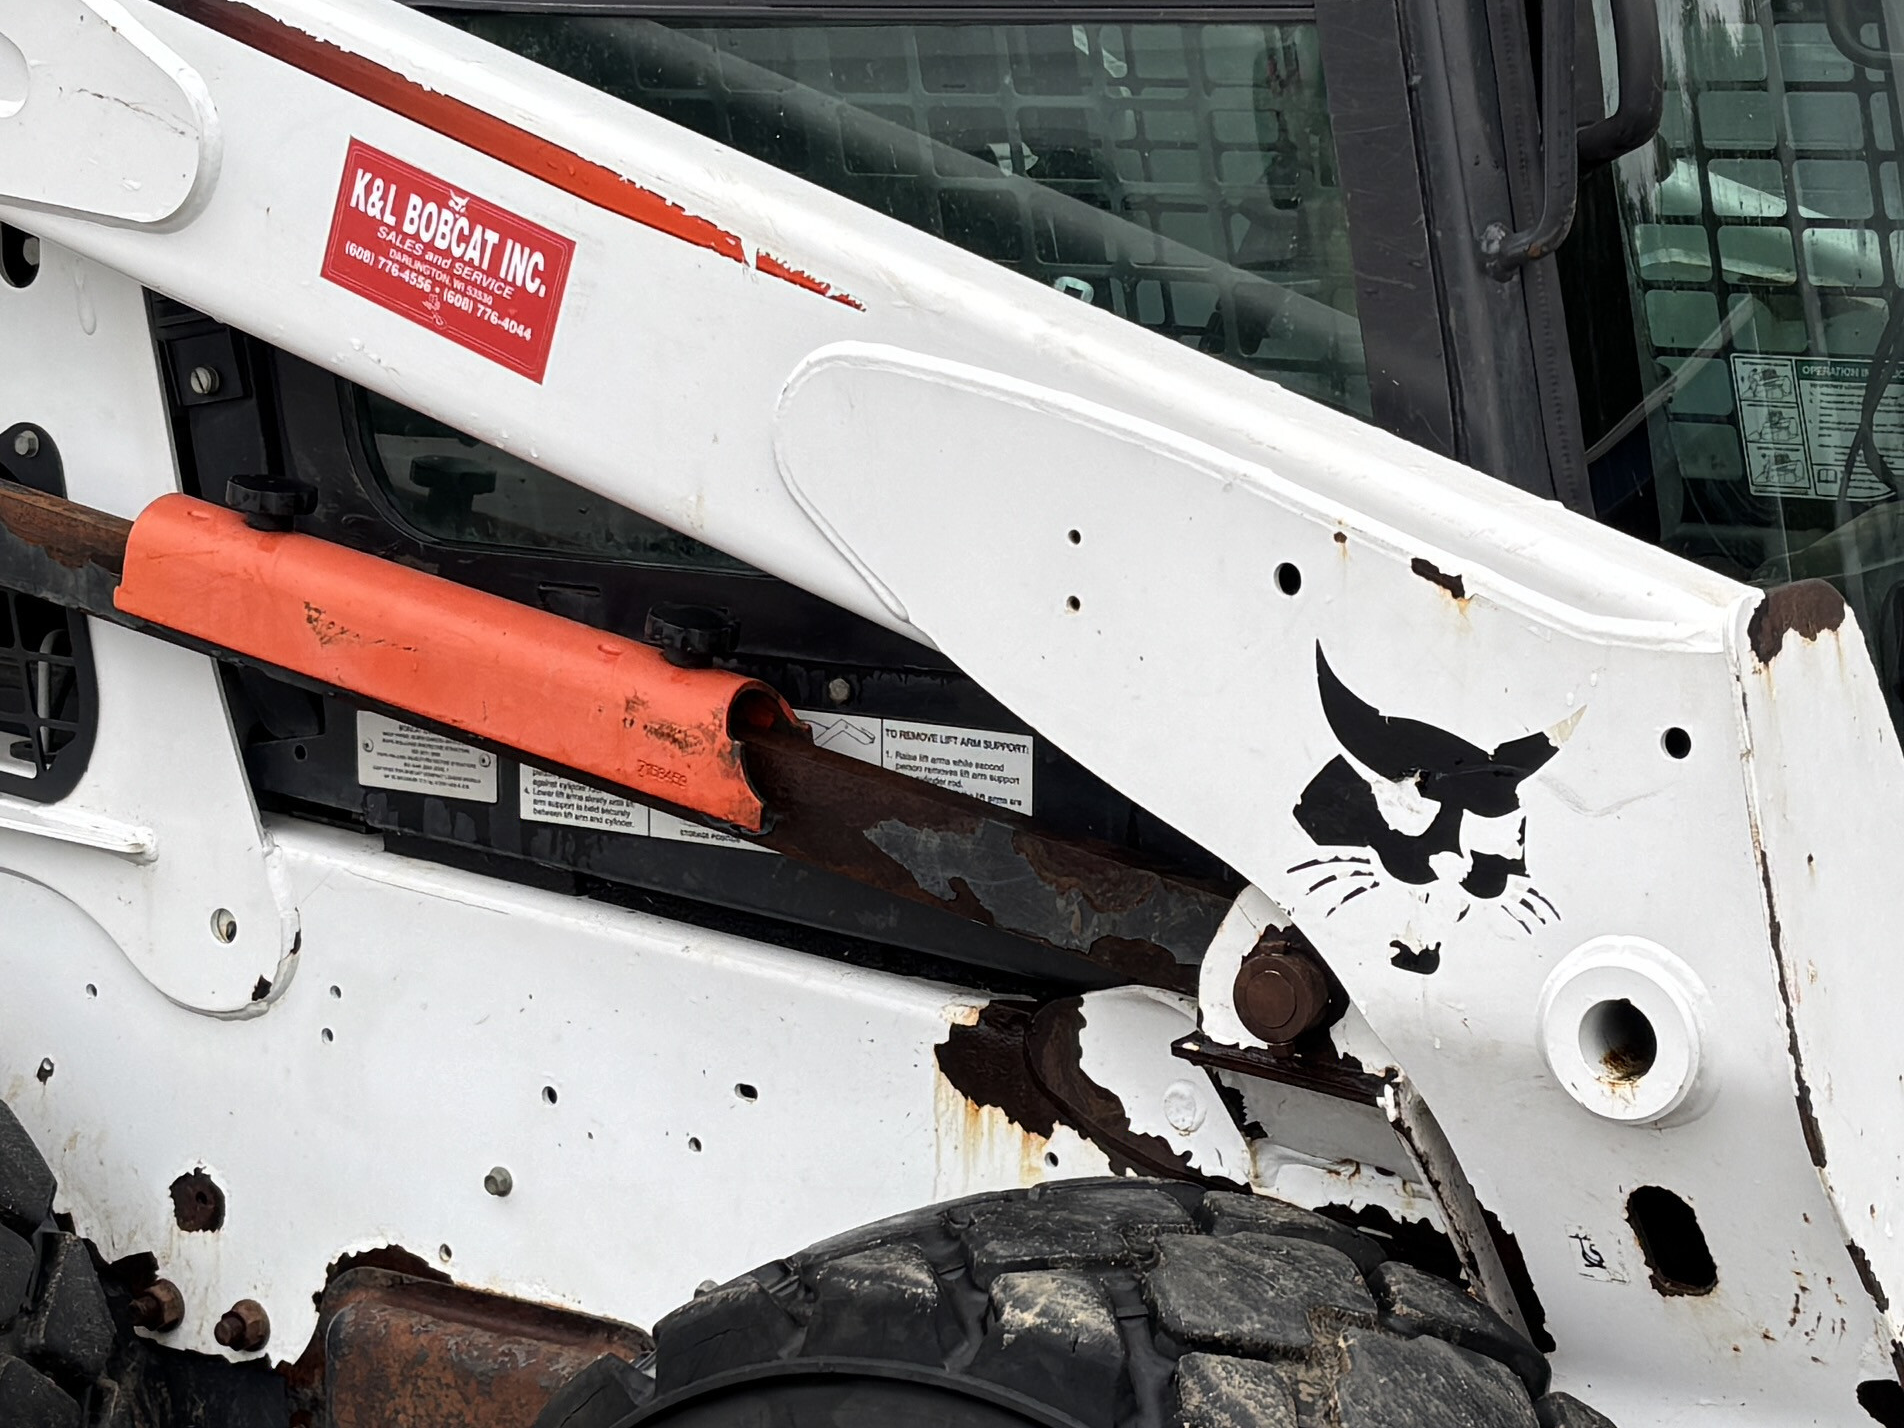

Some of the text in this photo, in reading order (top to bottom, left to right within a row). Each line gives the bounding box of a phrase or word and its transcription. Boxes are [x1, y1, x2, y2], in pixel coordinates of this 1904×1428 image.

[350, 168, 546, 298] K&L BOBCAT INC.
[377, 226, 515, 300] SALES and SERVICE
[378, 255, 433, 292] 776-4556
[477, 303, 532, 342] 776-4044
[885, 728, 897, 739] TO
[899, 730, 938, 744] REMOVE
[939, 734, 958, 745] LIFT
[960, 737, 981, 748] ARM
